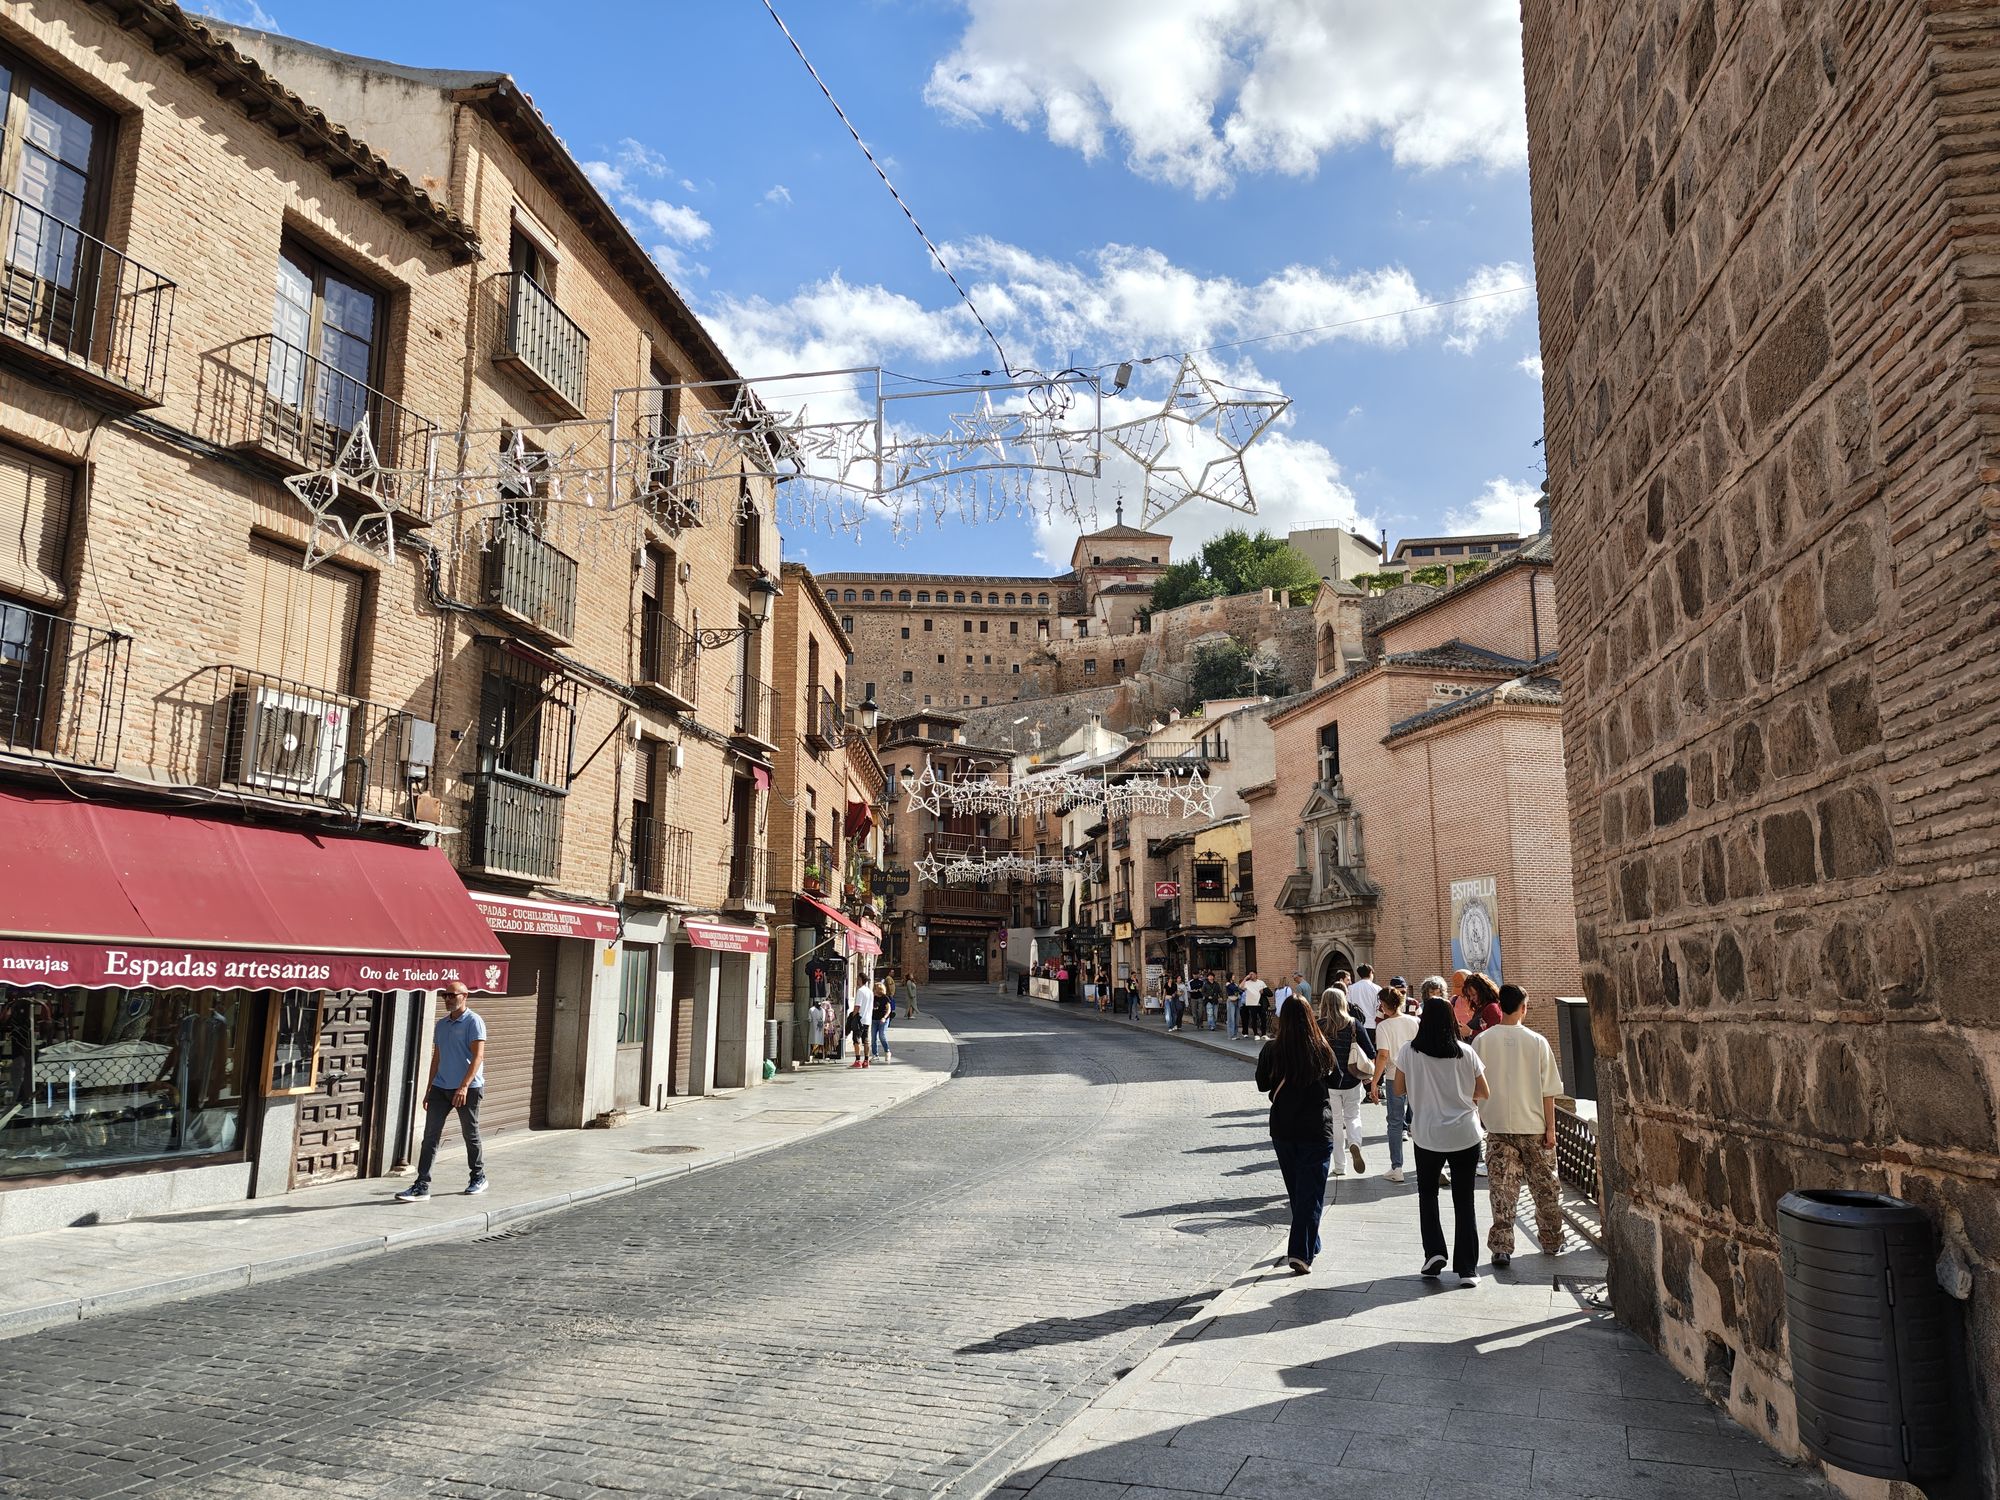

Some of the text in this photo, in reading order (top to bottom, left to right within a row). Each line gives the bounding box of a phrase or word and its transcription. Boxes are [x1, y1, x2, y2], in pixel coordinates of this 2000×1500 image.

[1451, 878, 1497, 901] ESTRELLA
[475, 903, 507, 917] SPADAS
[512, 908, 558, 923] CUCHILLERÍA
[558, 913, 582, 925] MUELA
[524, 922, 534, 931] DE
[535, 922, 574, 934] ARTESANÍA
[2, 955, 69, 975] navajas
[104, 950, 330, 984] Espadas artesanas
[359, 966, 460, 981] Oro de Toledo 24k
